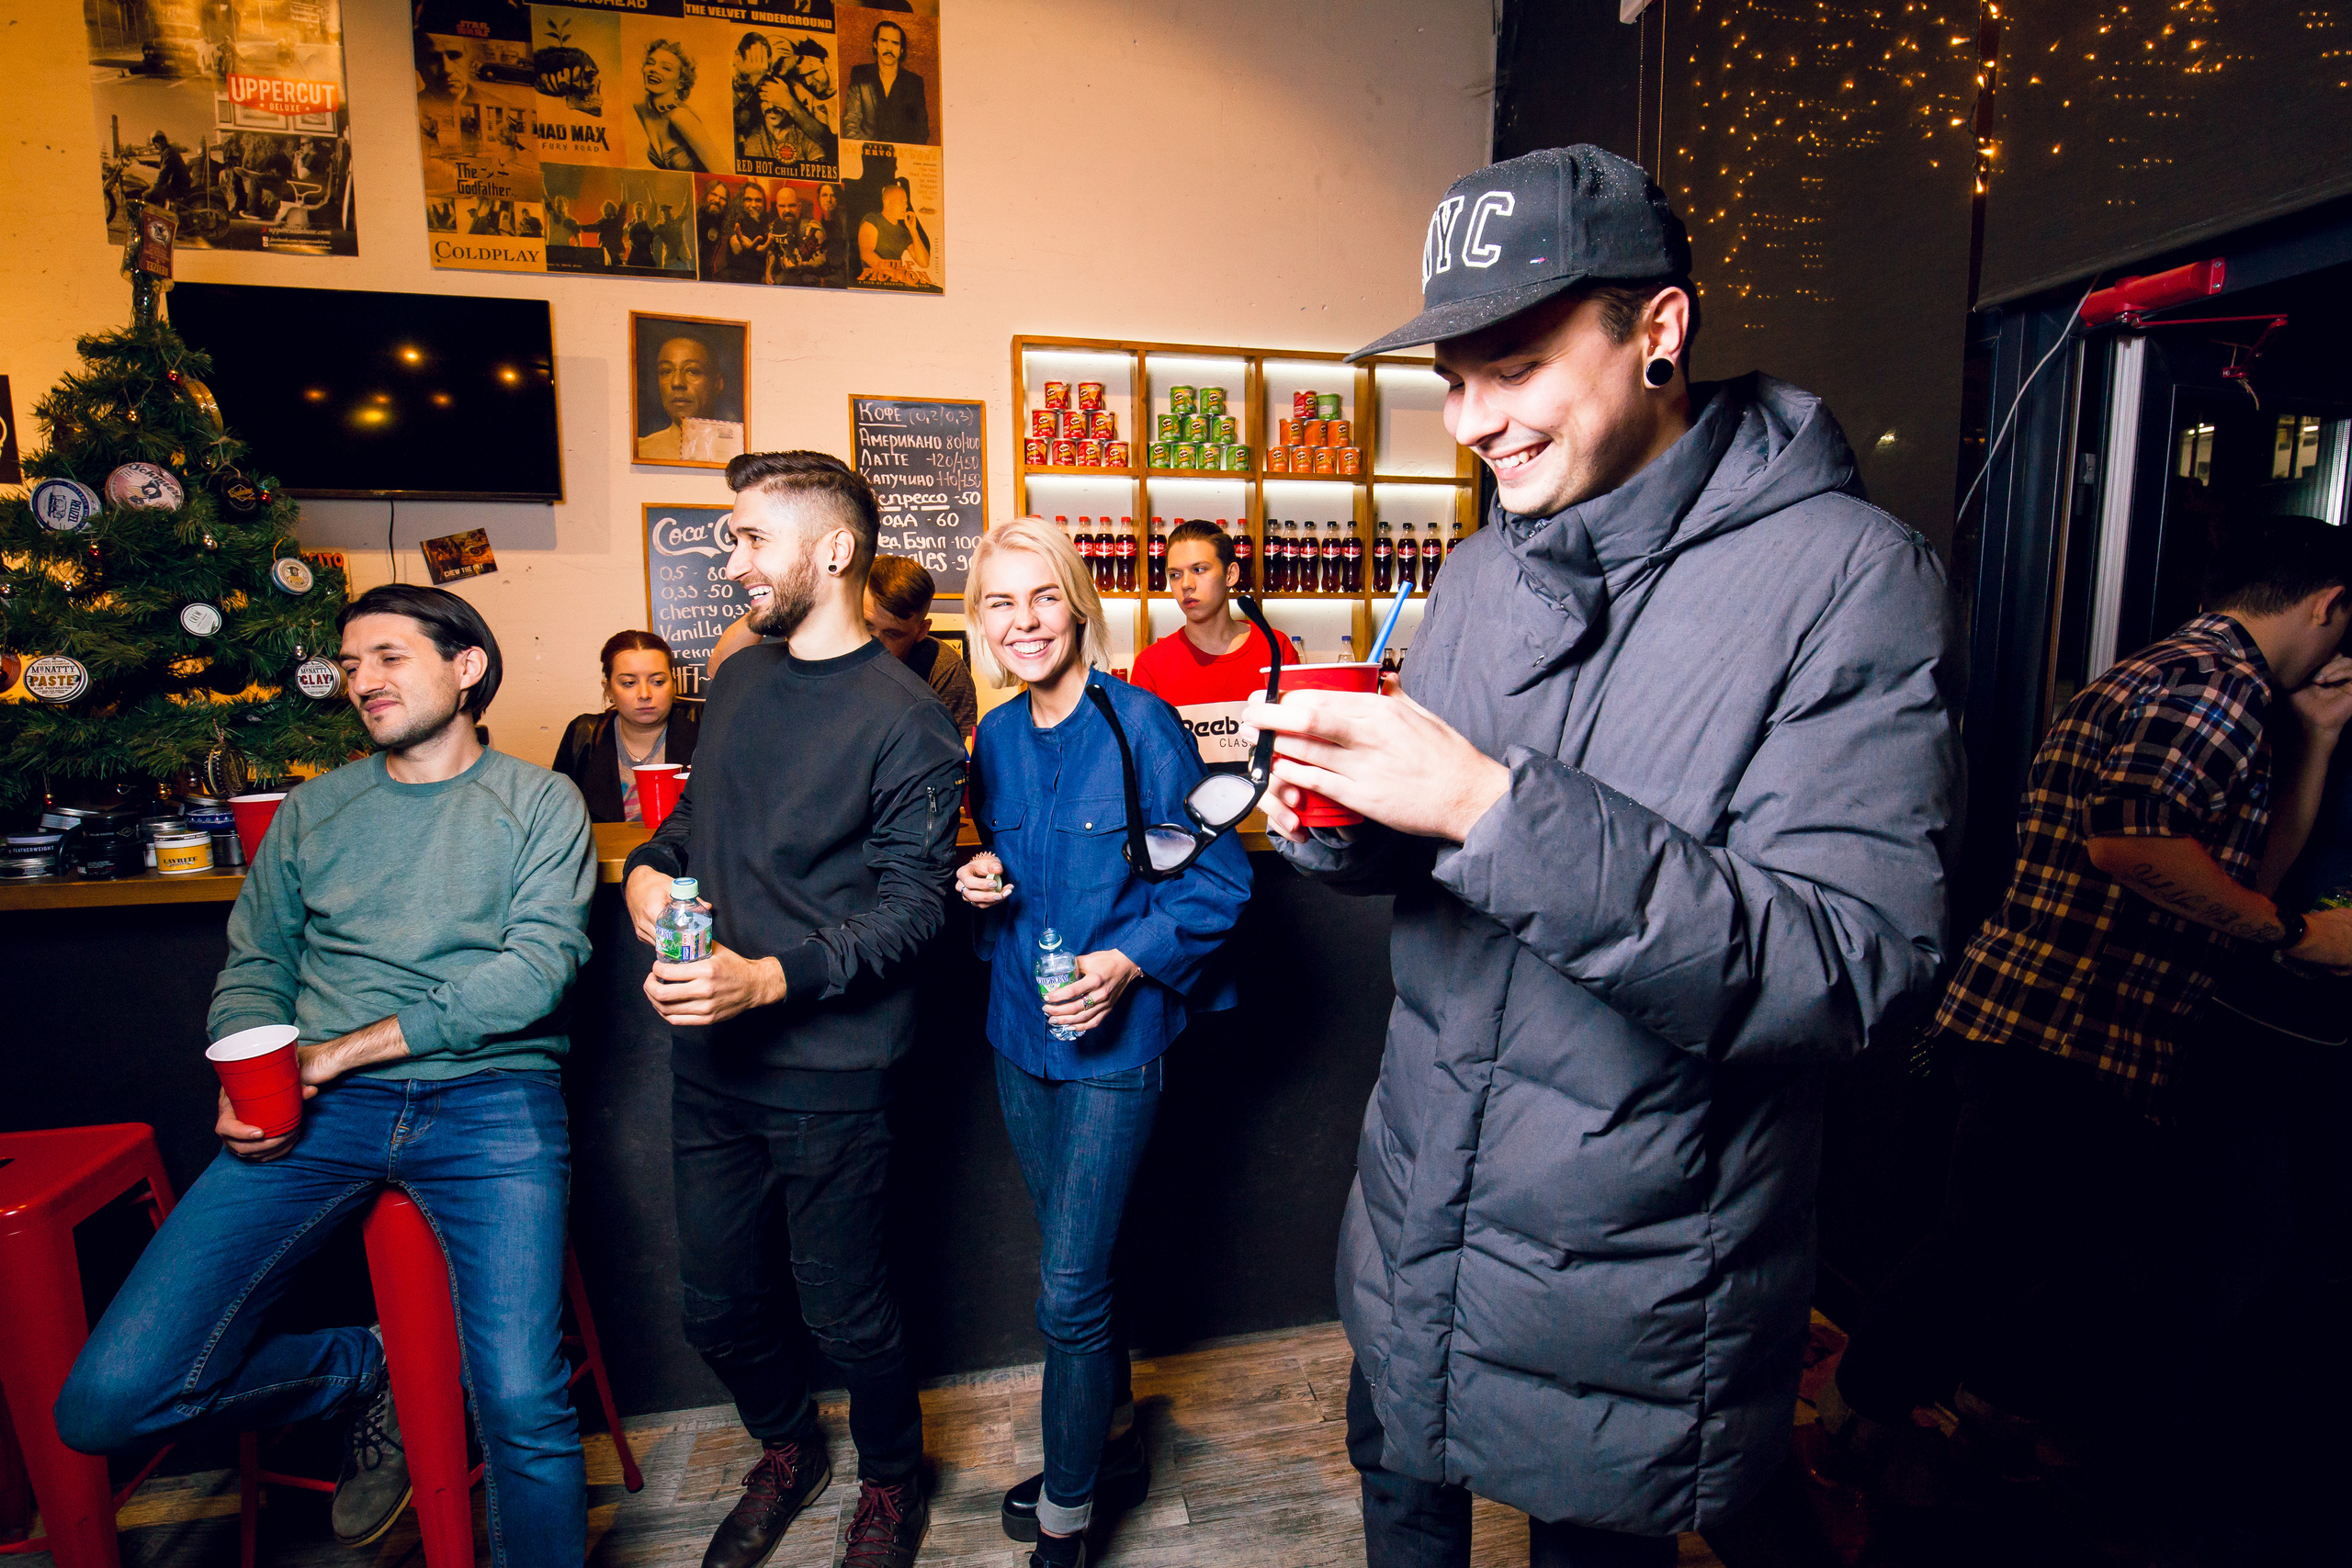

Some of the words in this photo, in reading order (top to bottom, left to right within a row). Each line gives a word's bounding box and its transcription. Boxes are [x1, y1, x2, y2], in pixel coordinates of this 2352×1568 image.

[459, 20, 488, 29] STAR
[685, 5, 707, 16] THE
[707, 6, 747, 19] VELVET
[751, 10, 832, 29] UNDERGROUND
[457, 27, 491, 37] WARS
[231, 76, 335, 109] UPPERCUT
[269, 102, 301, 113] DELUXE
[571, 124, 610, 152] MAX
[542, 142, 568, 151] FURY
[574, 144, 600, 152] ROAD
[456, 162, 478, 179] The
[736, 158, 753, 173] RED
[755, 160, 774, 175] HOT
[775, 166, 797, 176] CHILI
[800, 163, 838, 179] PEPPERS
[457, 179, 512, 197] Godfather
[435, 240, 540, 263] COLDPLAY
[876, 493, 948, 509] спрессо
[68, 499, 82, 524] REUZEL
[935, 513, 959, 527] 60
[652, 513, 738, 557] Coca-C
[660, 566, 688, 582] 0,5
[707, 566, 727, 581] 80
[661, 586, 698, 602] 0,33
[30, 675, 74, 686] PASTE
[300, 674, 329, 684] CLAY
[1219, 738, 1253, 748] CLAS
[12, 845, 54, 853] FEATHERWEIGHT
[163, 856, 198, 864] LAYRITE
